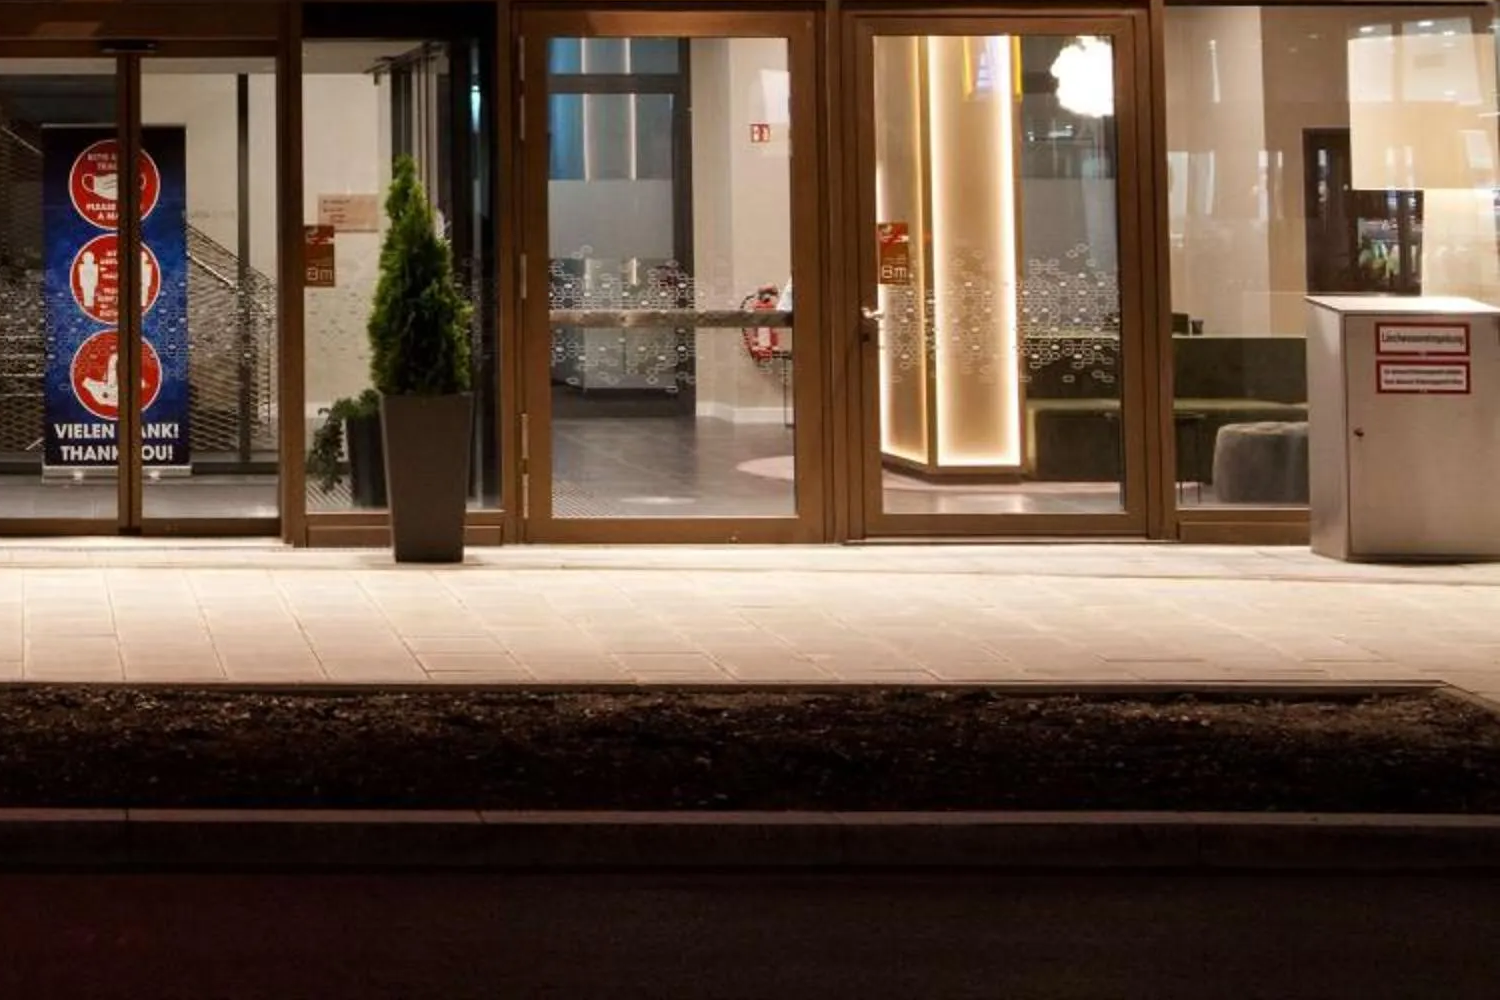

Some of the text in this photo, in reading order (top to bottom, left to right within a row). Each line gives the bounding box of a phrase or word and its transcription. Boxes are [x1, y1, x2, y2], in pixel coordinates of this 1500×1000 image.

[53, 423, 180, 439] VIELEN NK!
[141, 445, 173, 461] OU!
